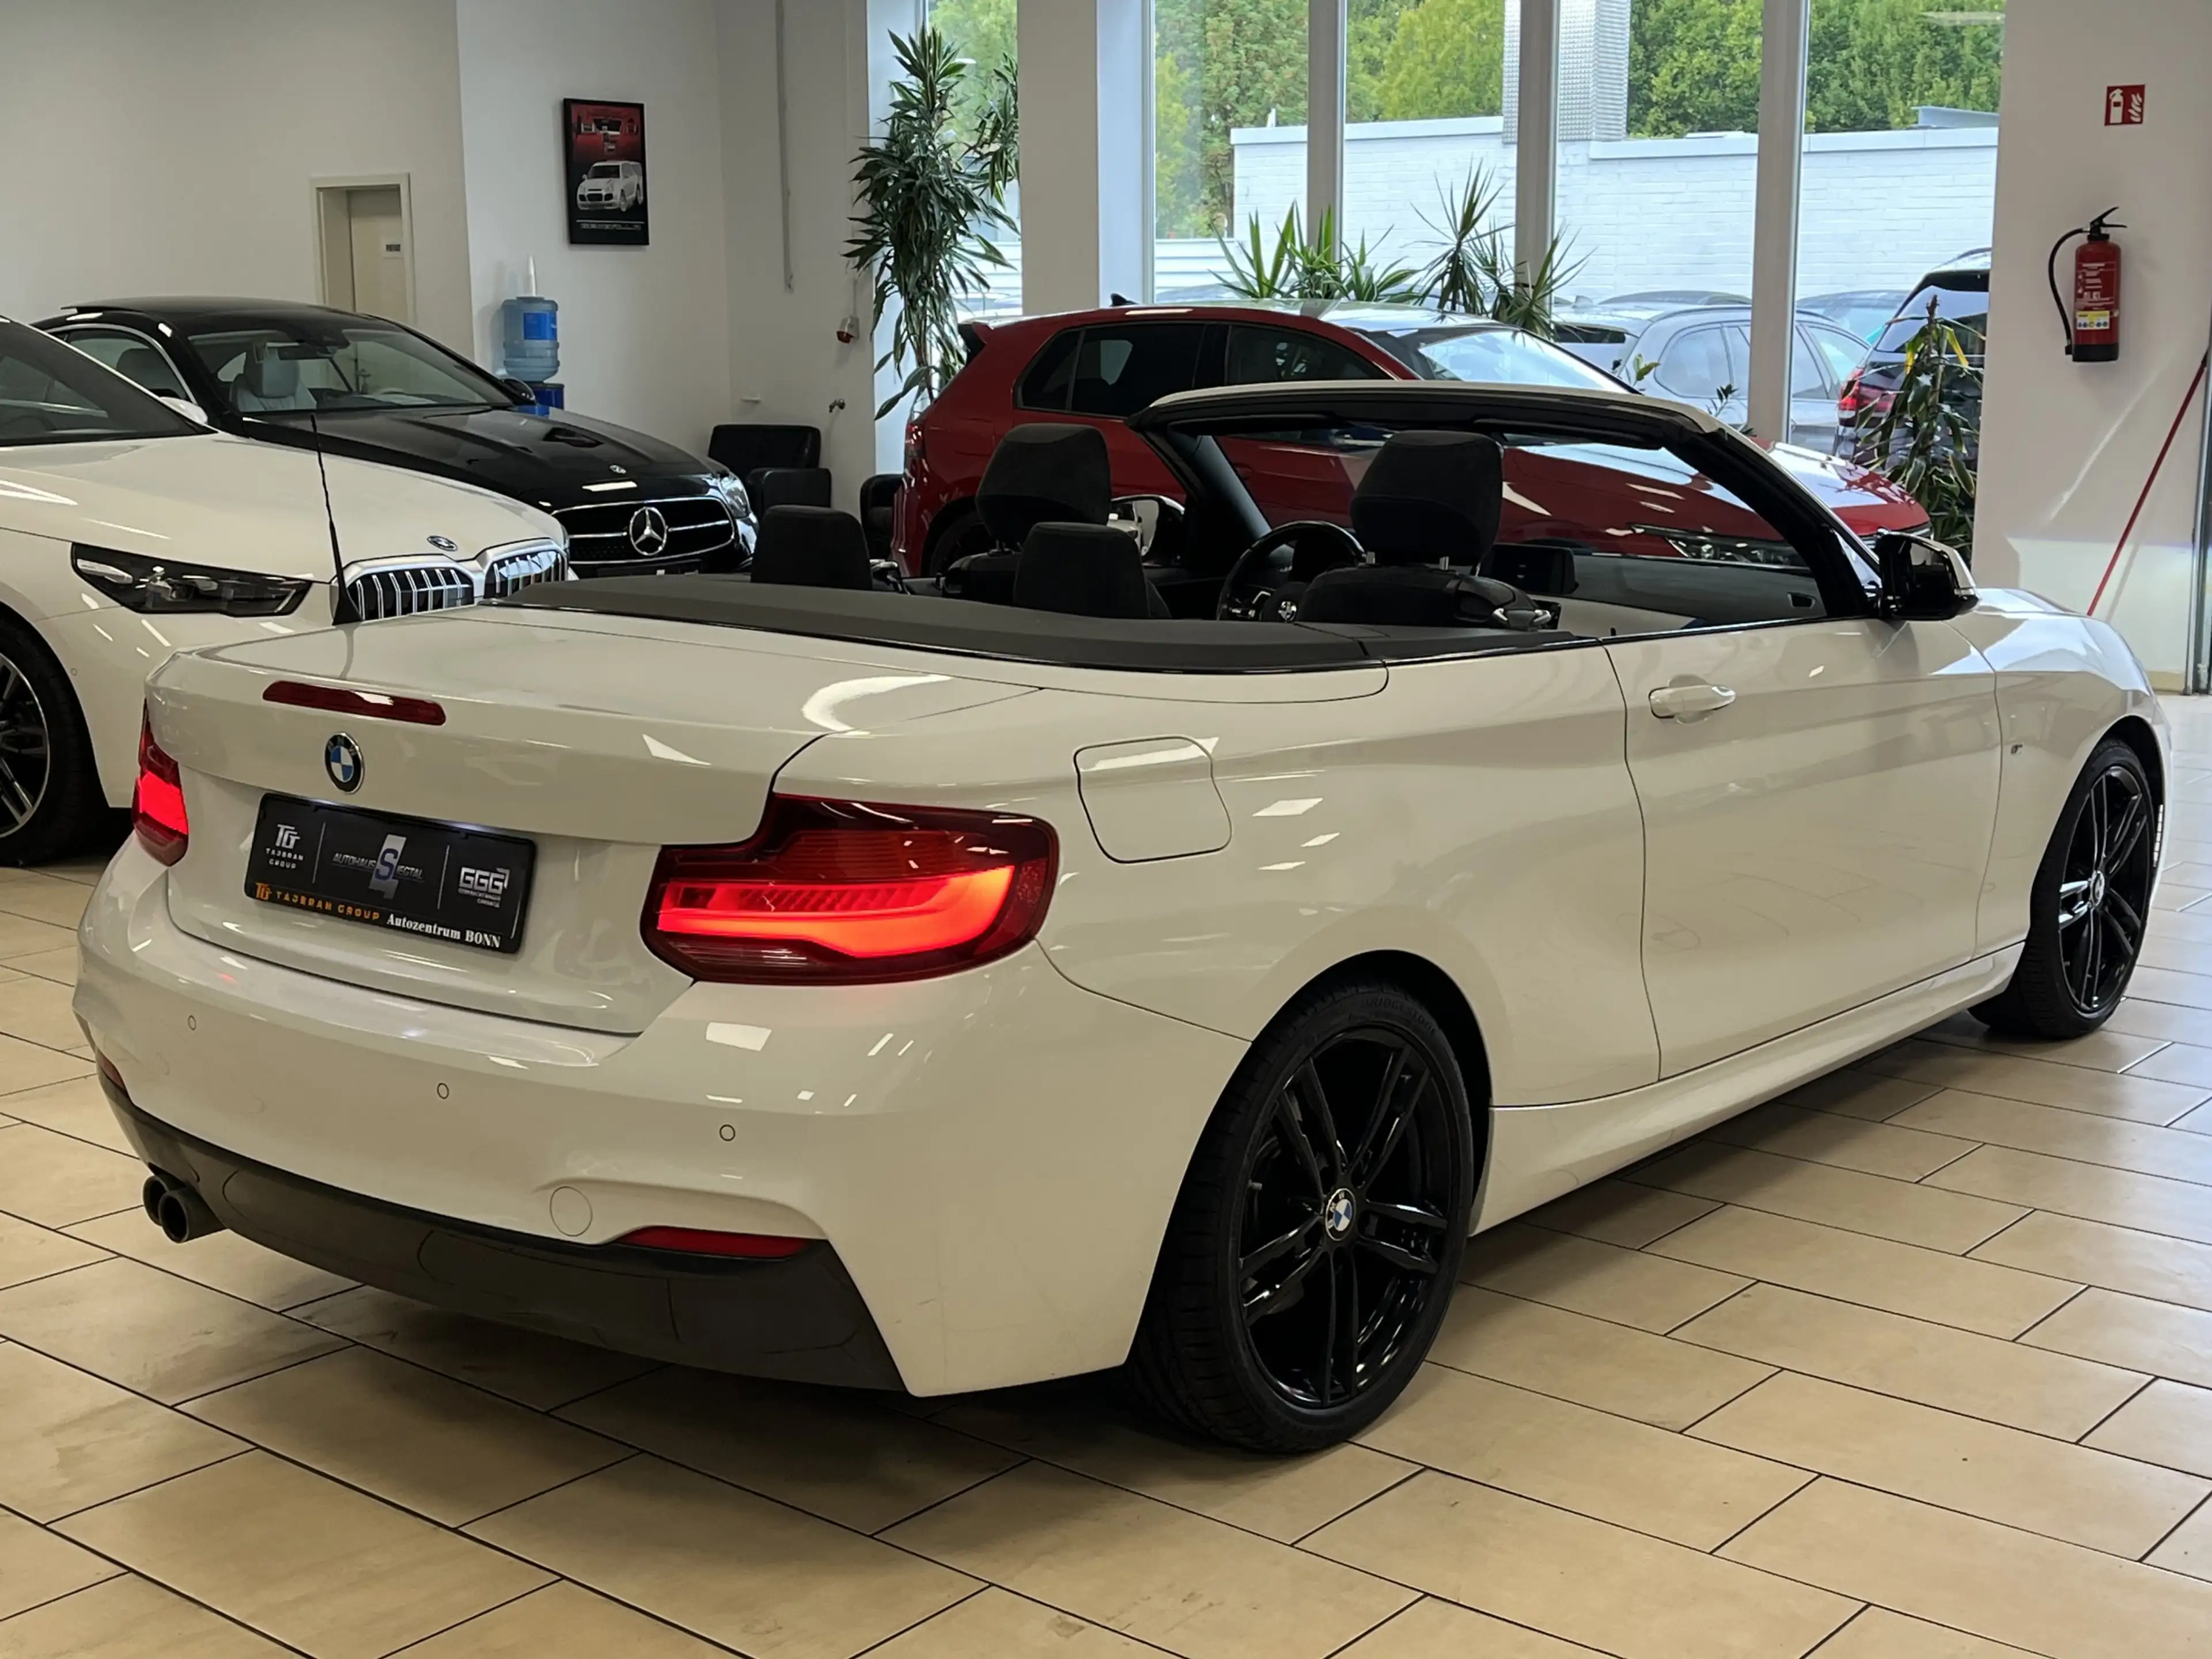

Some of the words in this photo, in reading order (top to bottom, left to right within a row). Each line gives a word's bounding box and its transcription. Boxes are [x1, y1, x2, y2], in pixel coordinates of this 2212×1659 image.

[332, 853, 376, 868] AUTOHAUS
[459, 867, 510, 895] GGG
[338, 904, 380, 921] GROUP
[387, 914, 461, 940] Autozentrum
[464, 929, 501, 948] BONN
